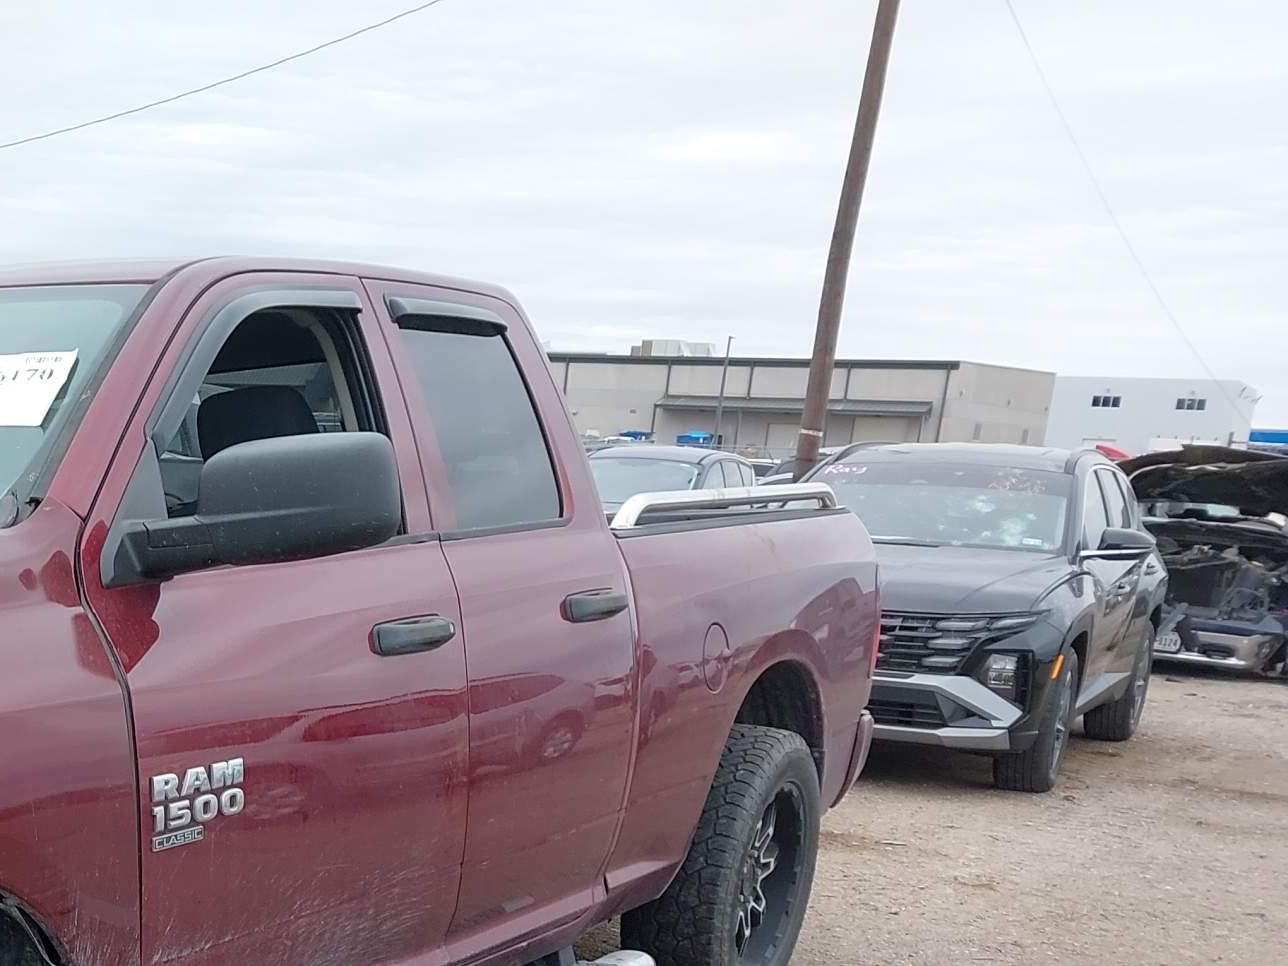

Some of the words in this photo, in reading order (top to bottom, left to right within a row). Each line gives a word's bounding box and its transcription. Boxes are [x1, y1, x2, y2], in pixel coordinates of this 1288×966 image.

[150, 757, 244, 802] RAM
[151, 787, 245, 832] 1500
[155, 828, 202, 850] CLASSIC
